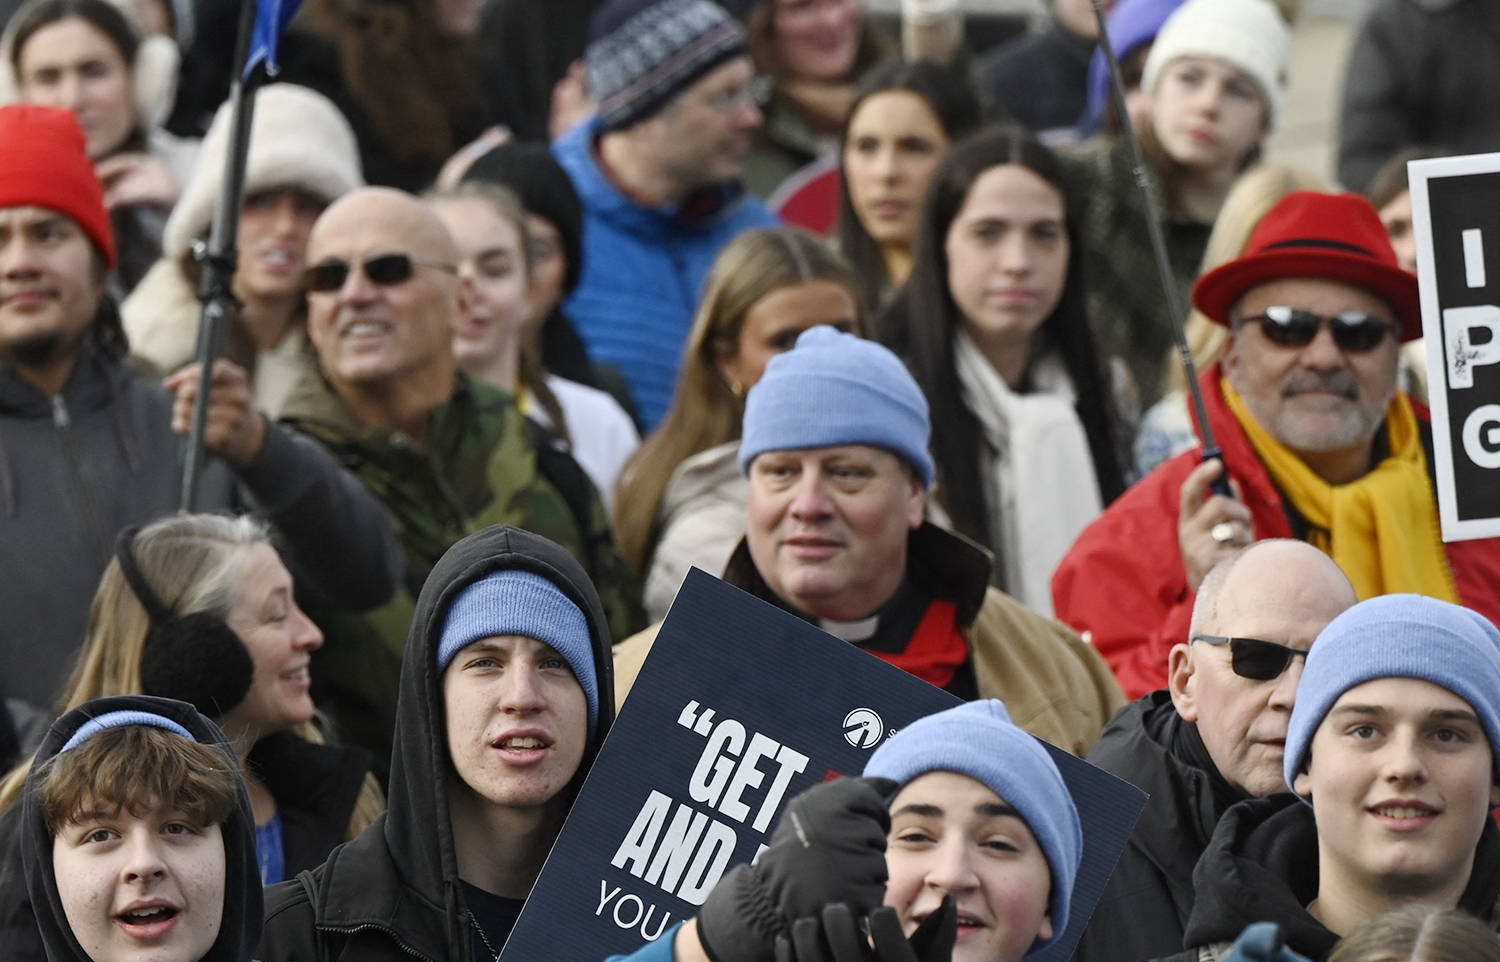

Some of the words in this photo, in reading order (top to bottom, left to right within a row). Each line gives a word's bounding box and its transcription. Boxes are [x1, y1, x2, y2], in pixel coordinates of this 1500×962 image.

[1462, 228, 1487, 288] I
[610, 790, 737, 906] AND
[595, 880, 671, 942] YOU
